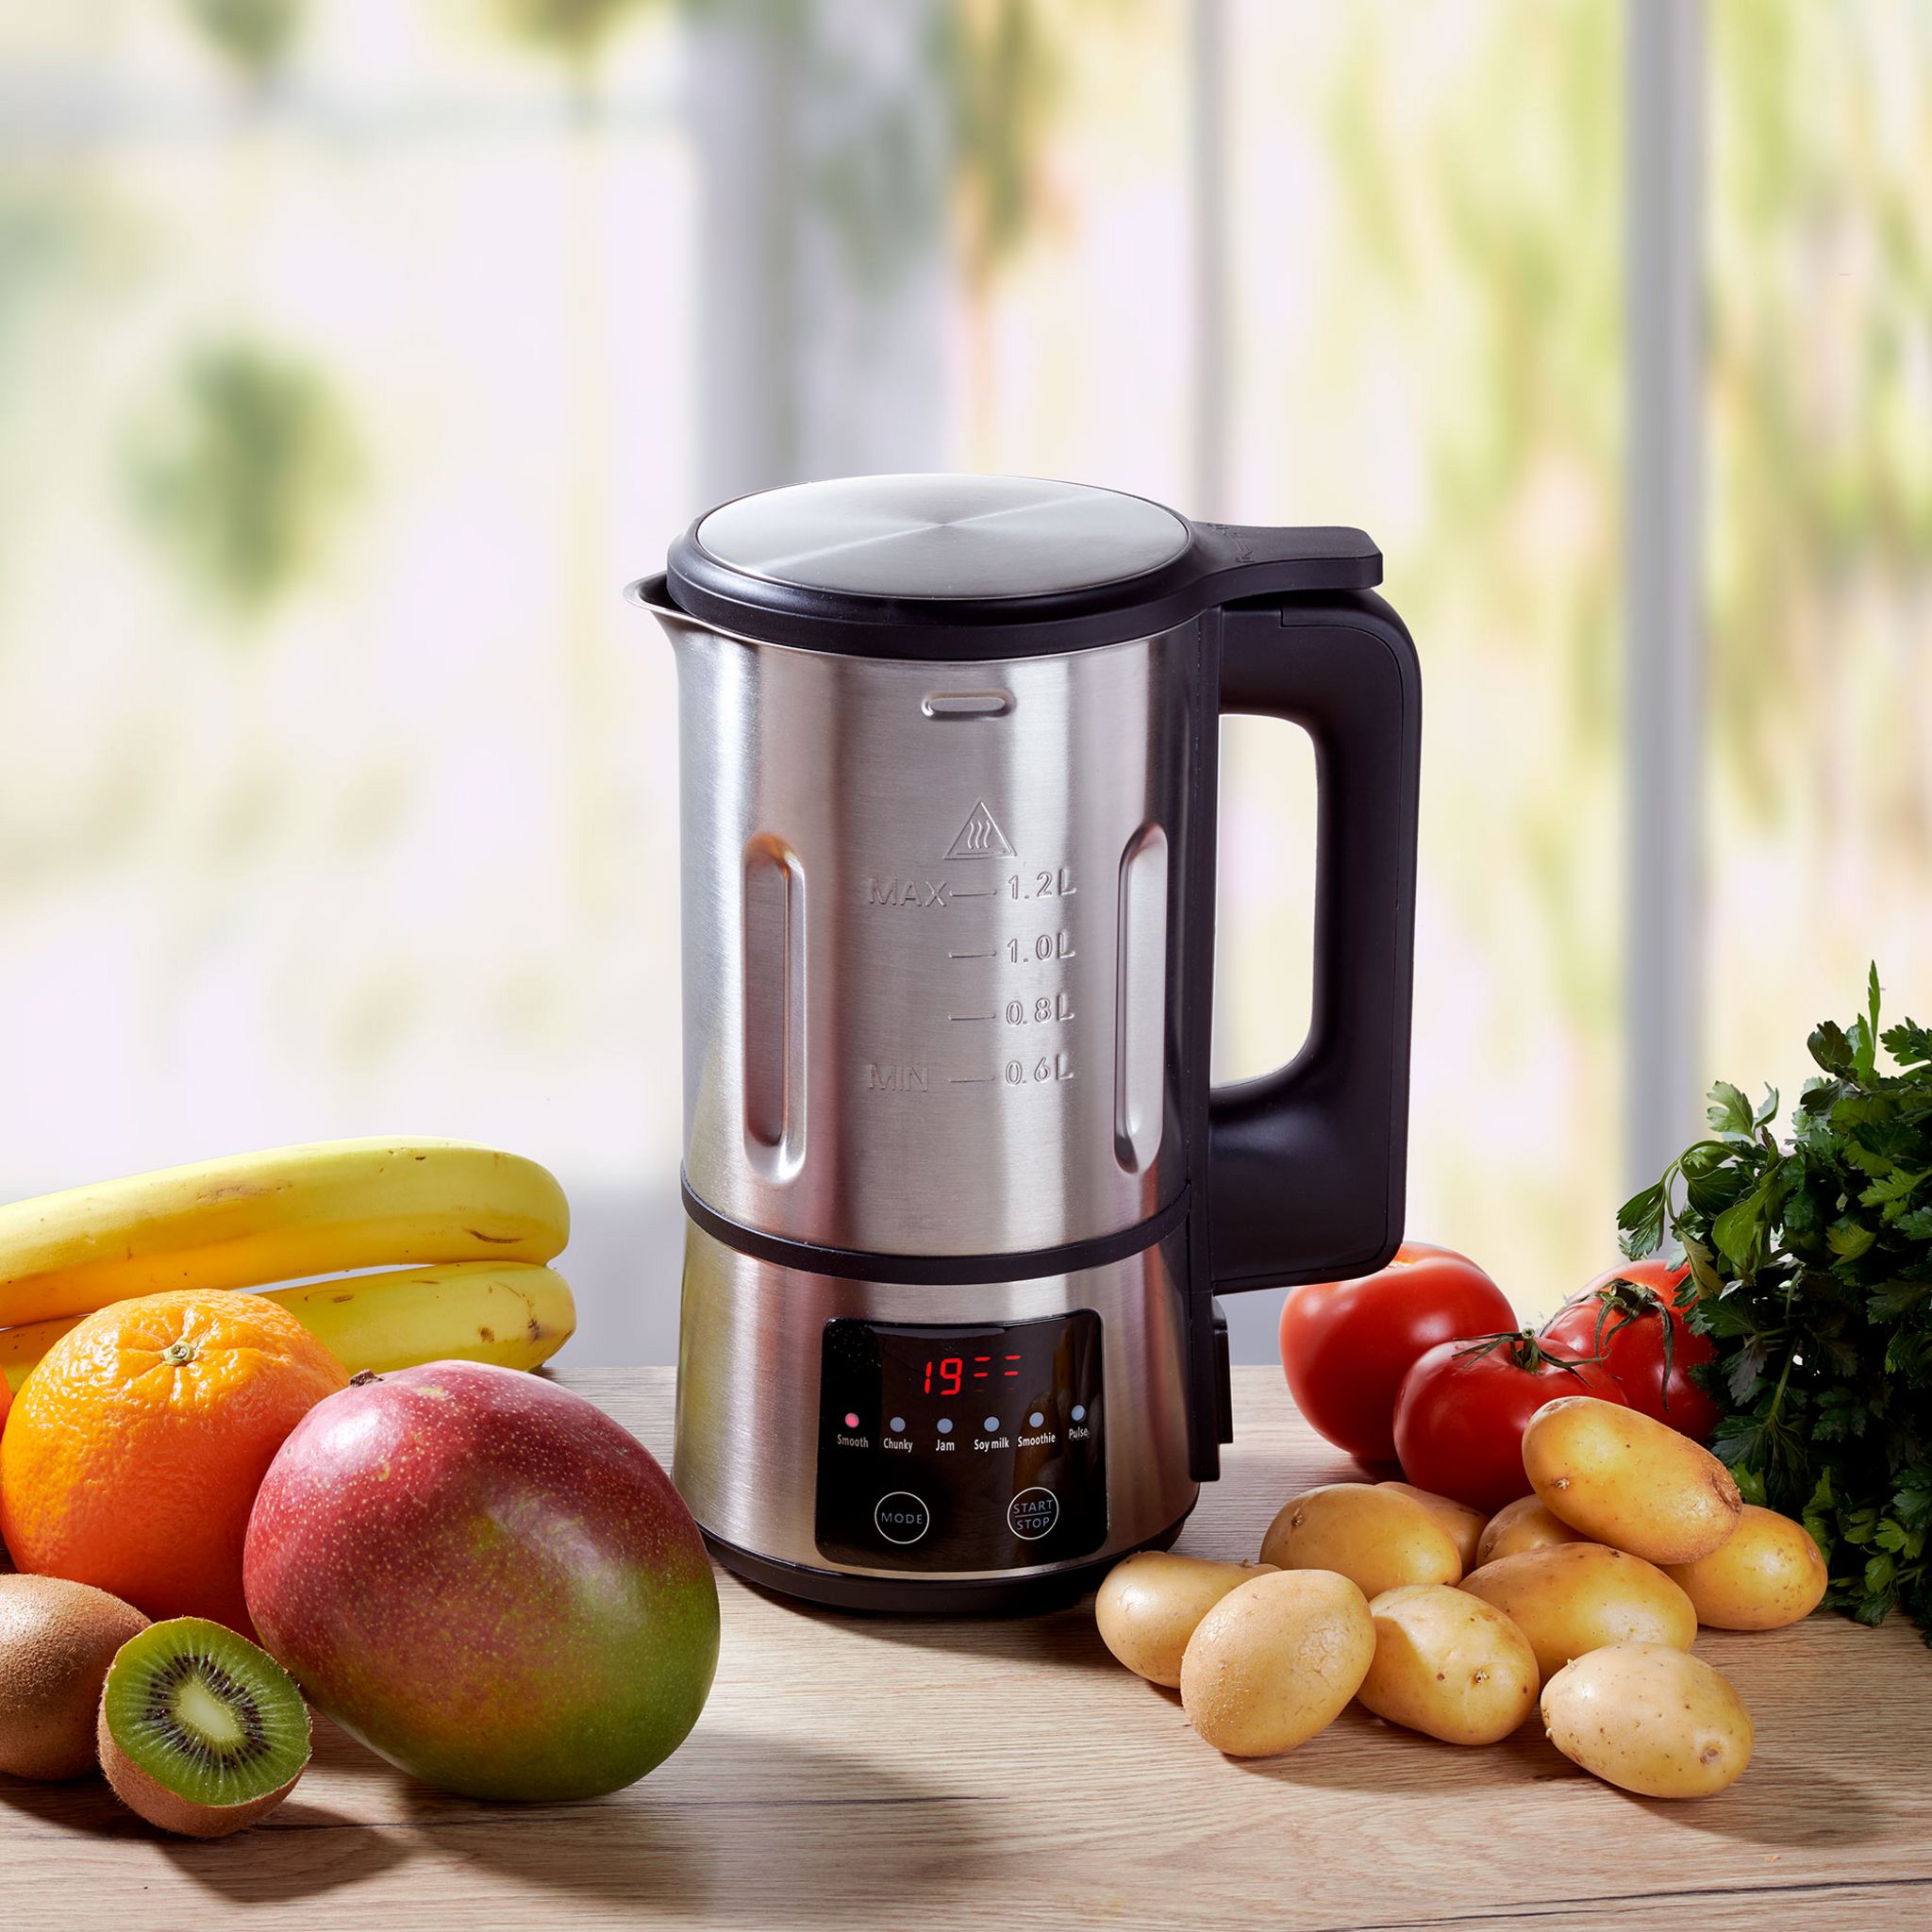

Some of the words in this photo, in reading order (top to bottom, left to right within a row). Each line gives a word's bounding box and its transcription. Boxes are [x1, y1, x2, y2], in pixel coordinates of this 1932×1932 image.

[869, 877, 947, 907] MAX
[868, 1063, 929, 1092] MIN
[1017, 1433, 1056, 1448] Smoothie
[1068, 1427, 1089, 1440] Pulse
[837, 1434, 869, 1448] Smooth
[883, 1438, 913, 1453] Chunky
[935, 1440, 955, 1452] Jam
[1013, 1499, 1054, 1514] START
[880, 1512, 924, 1524] MODE
[1017, 1516, 1050, 1530] STOP
